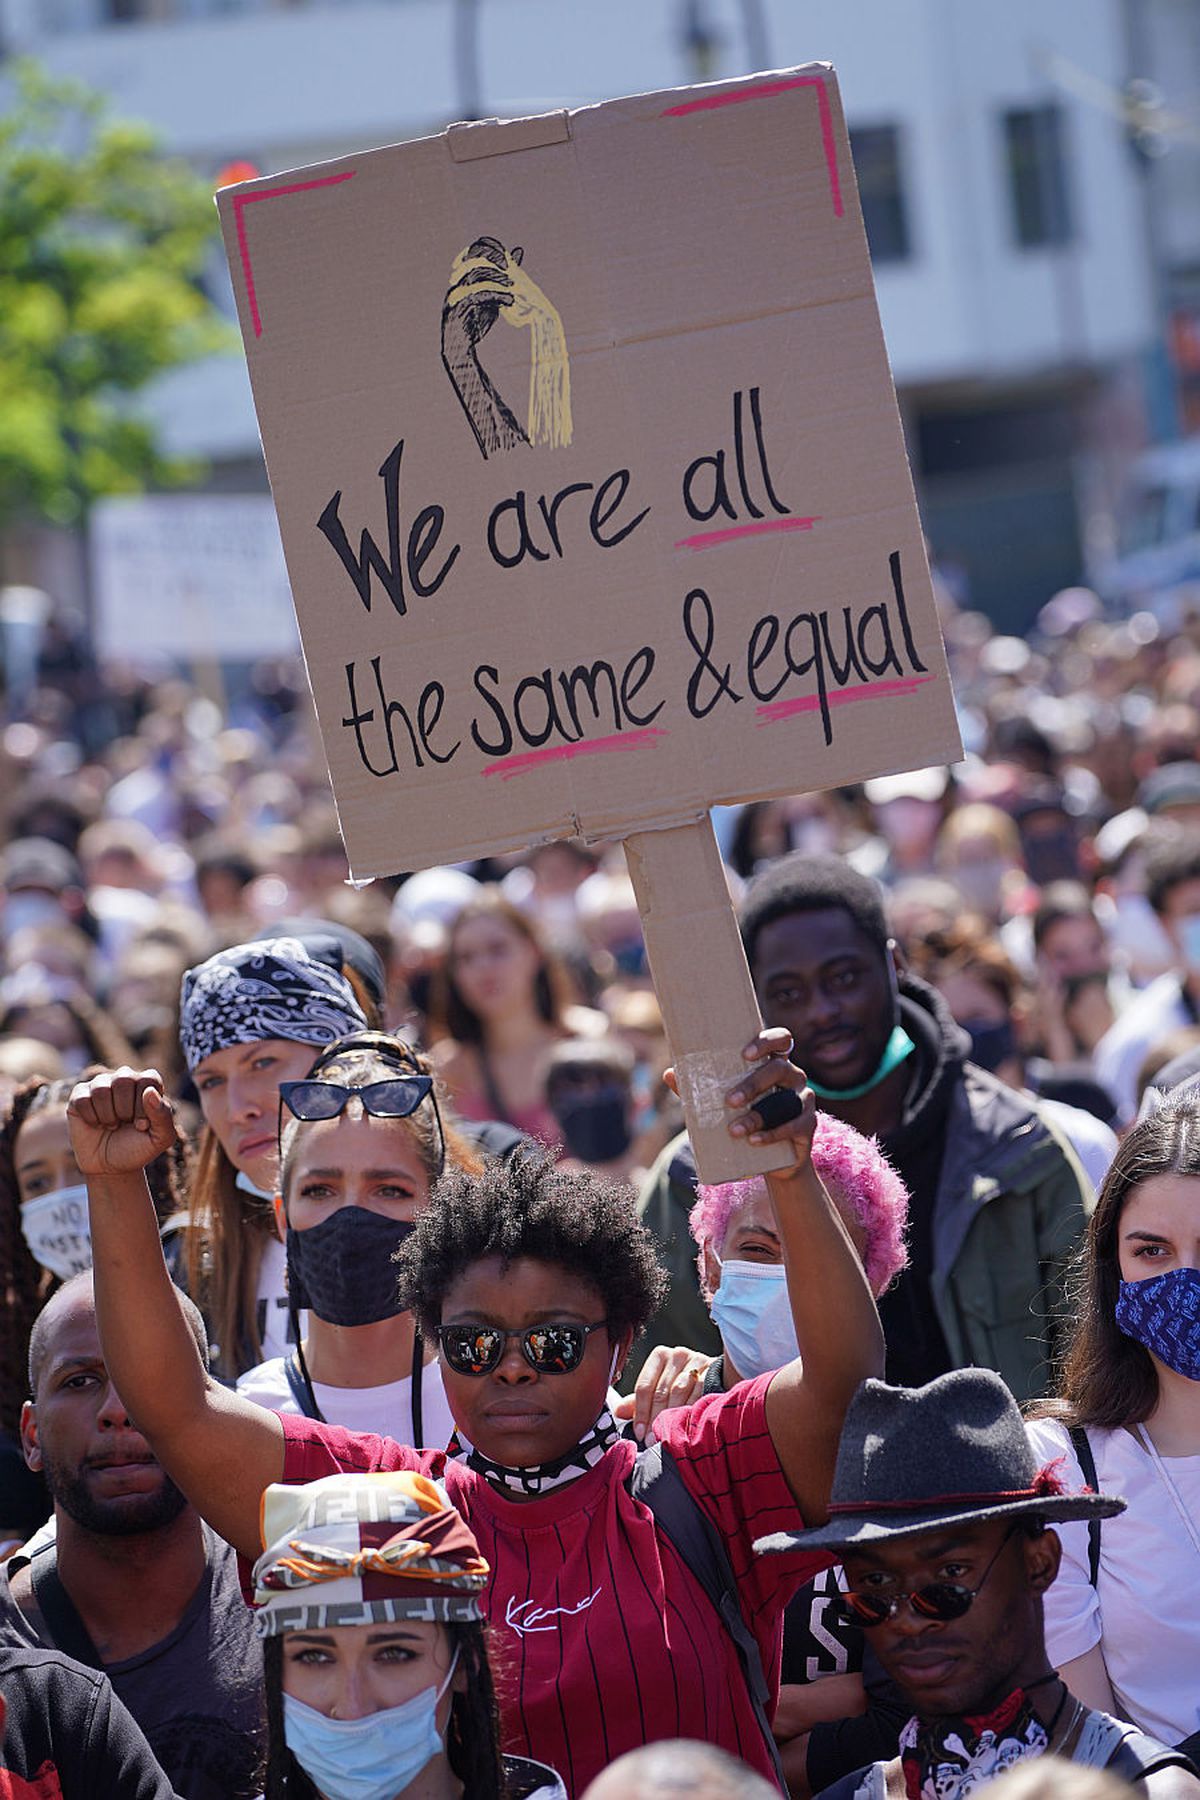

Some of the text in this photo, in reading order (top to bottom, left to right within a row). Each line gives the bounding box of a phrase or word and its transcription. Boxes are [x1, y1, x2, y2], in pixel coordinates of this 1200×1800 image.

[317, 439, 461, 616] We
[487, 468, 651, 569] are
[682, 387, 791, 522] all
[342, 551, 929, 777] the same & equal
